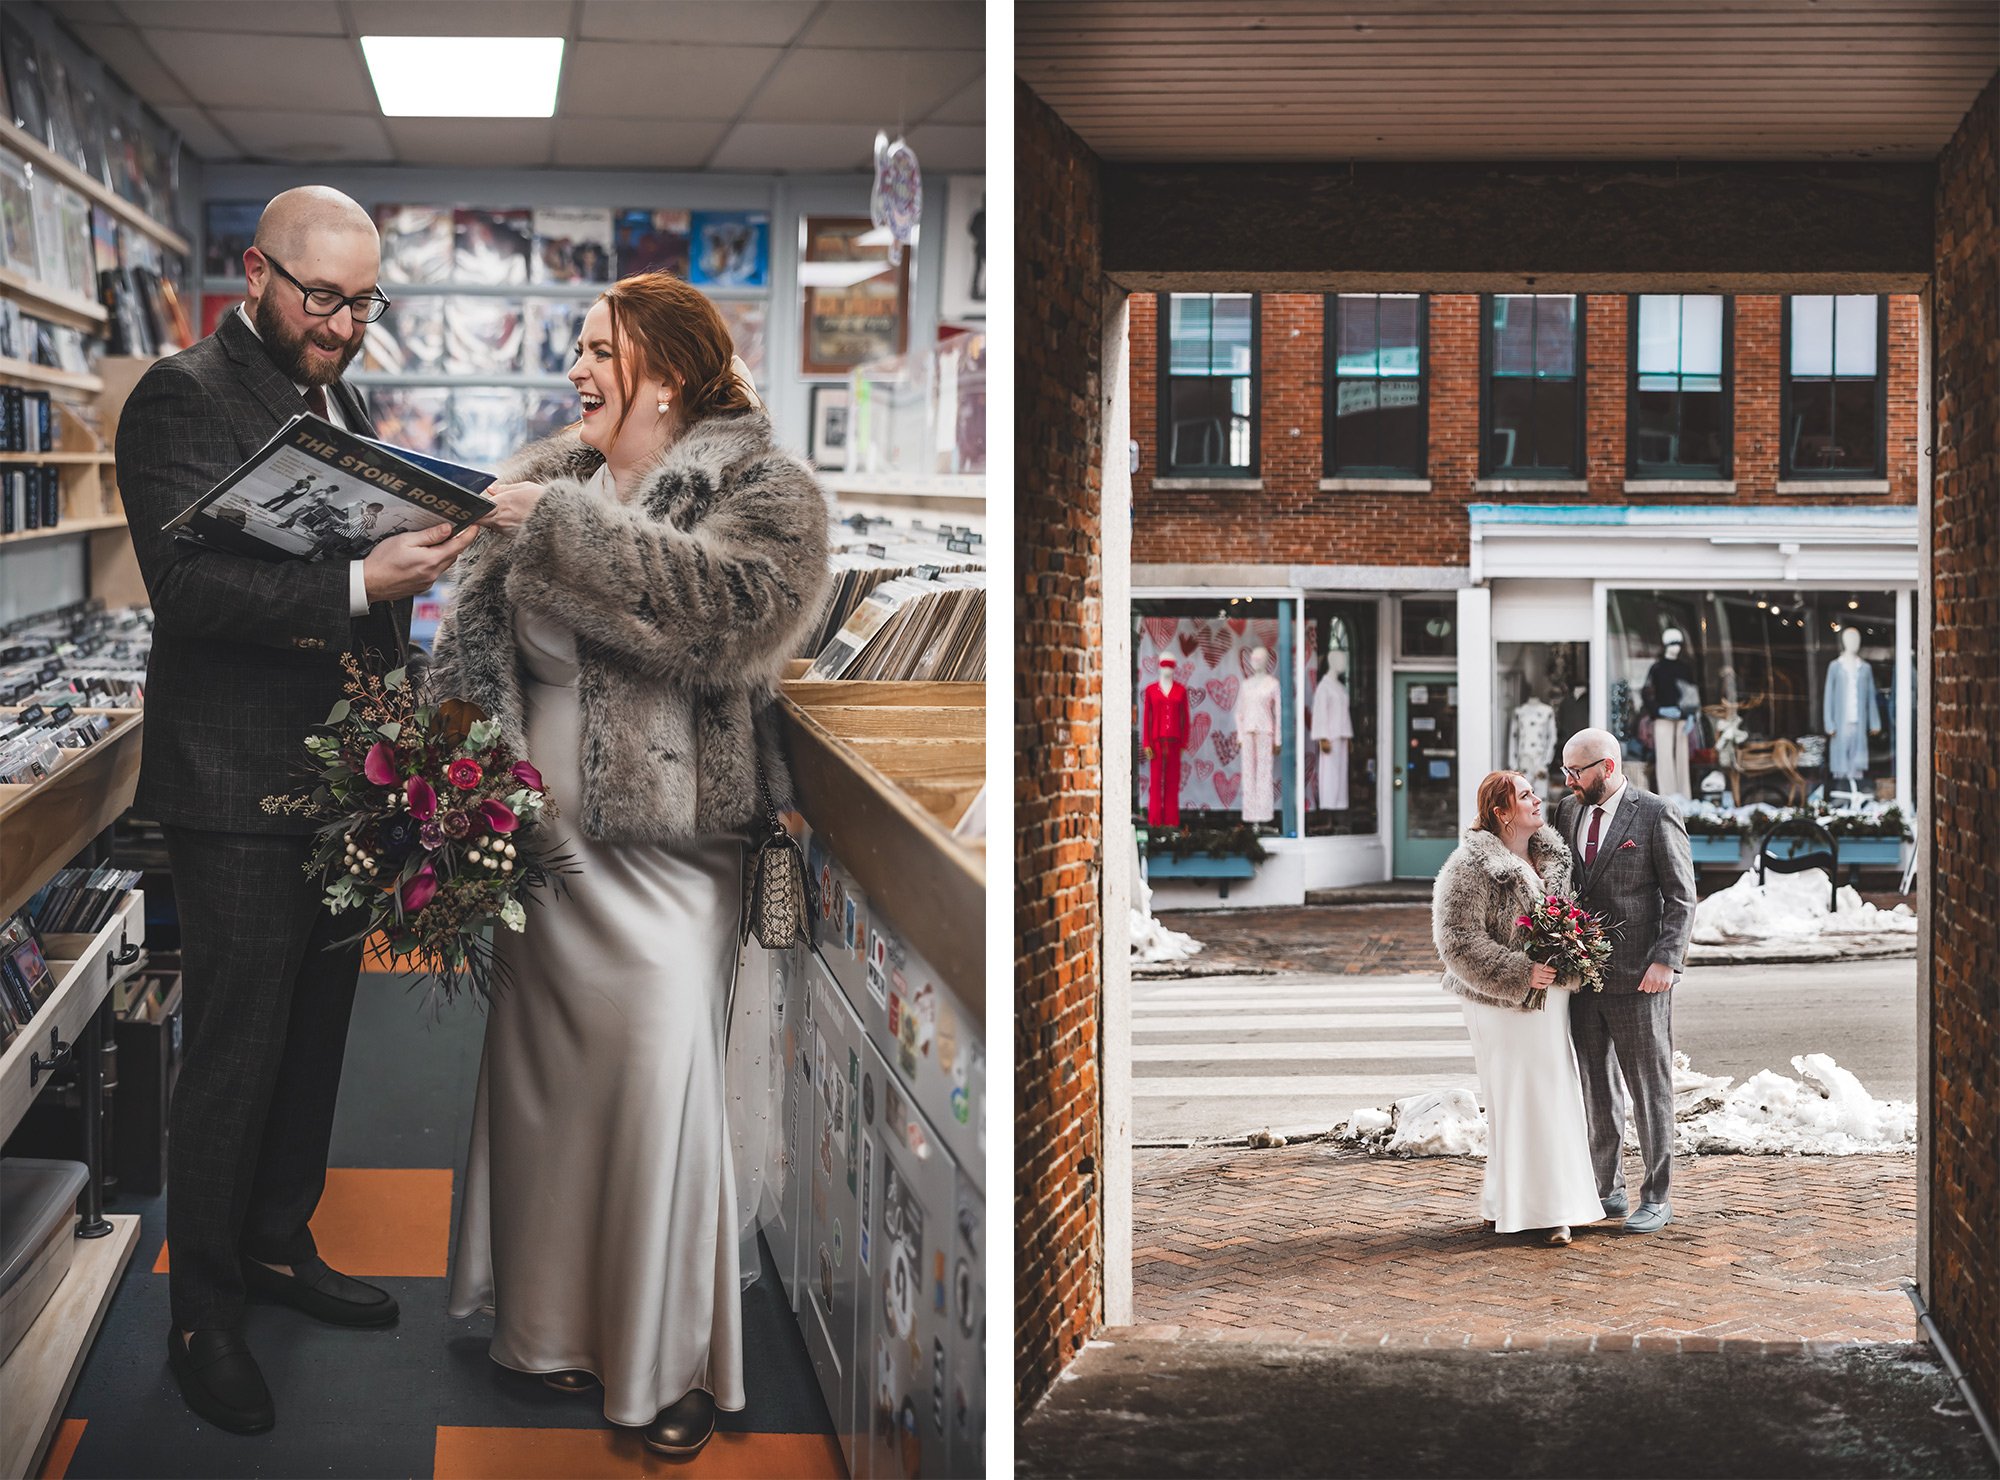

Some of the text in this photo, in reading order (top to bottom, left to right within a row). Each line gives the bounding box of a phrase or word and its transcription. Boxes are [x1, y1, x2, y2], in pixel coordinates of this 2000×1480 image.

[295, 432, 338, 459] THE
[338, 455, 409, 492] STONE
[407, 487, 473, 520] ROSES
